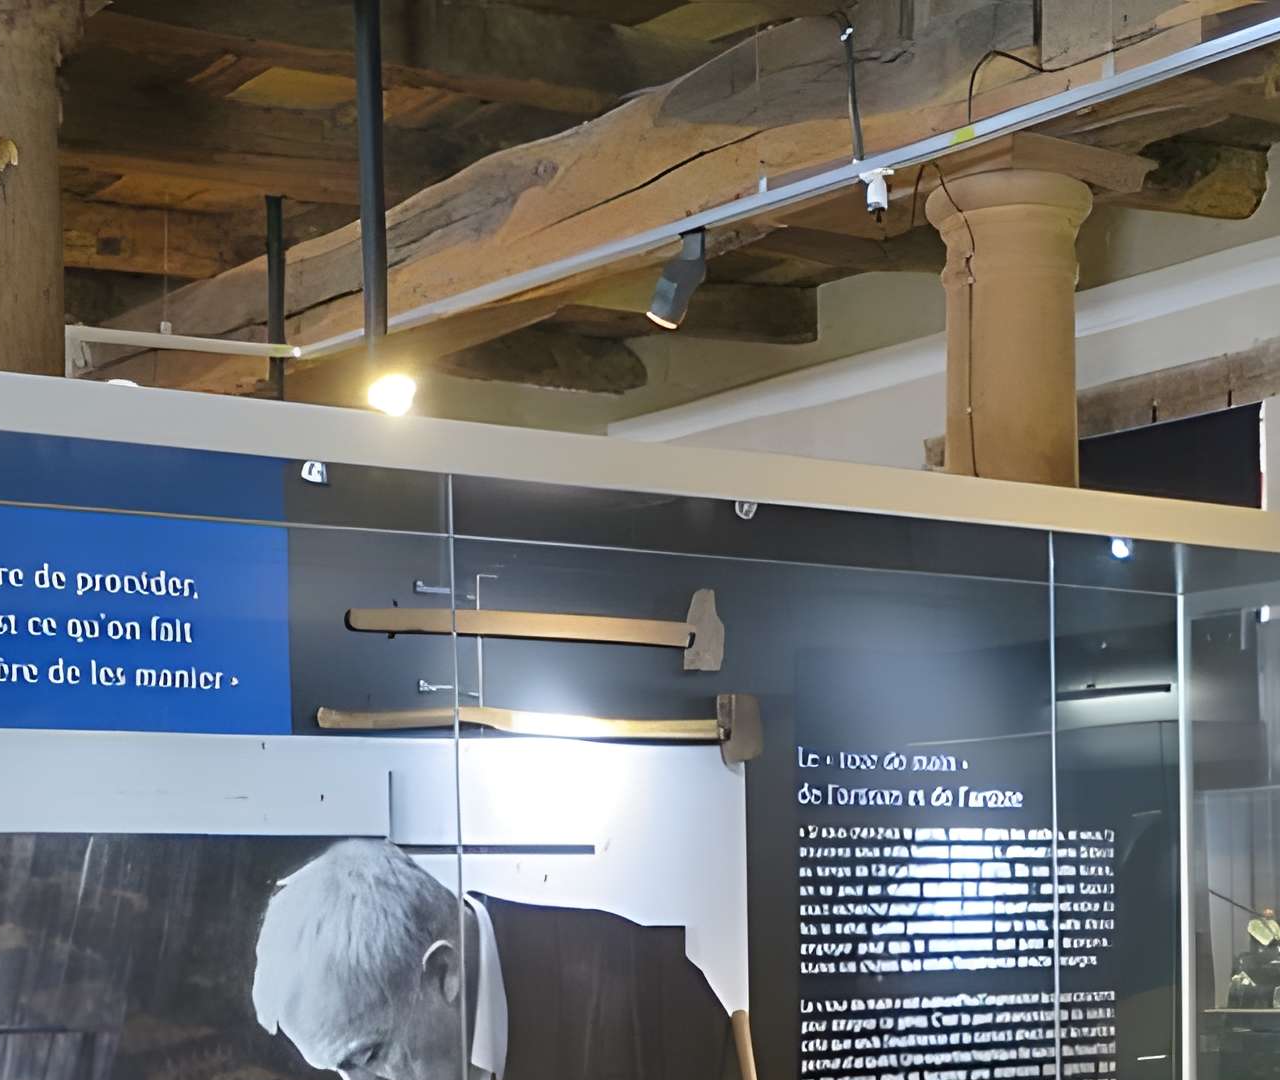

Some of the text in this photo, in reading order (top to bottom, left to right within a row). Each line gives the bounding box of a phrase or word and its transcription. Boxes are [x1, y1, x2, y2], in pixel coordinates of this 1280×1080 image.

[34, 562, 66, 590] de
[27, 616, 57, 636] ce
[67, 613, 141, 643] qu'on
[48, 657, 81, 685] de
[90, 659, 126, 686] les
